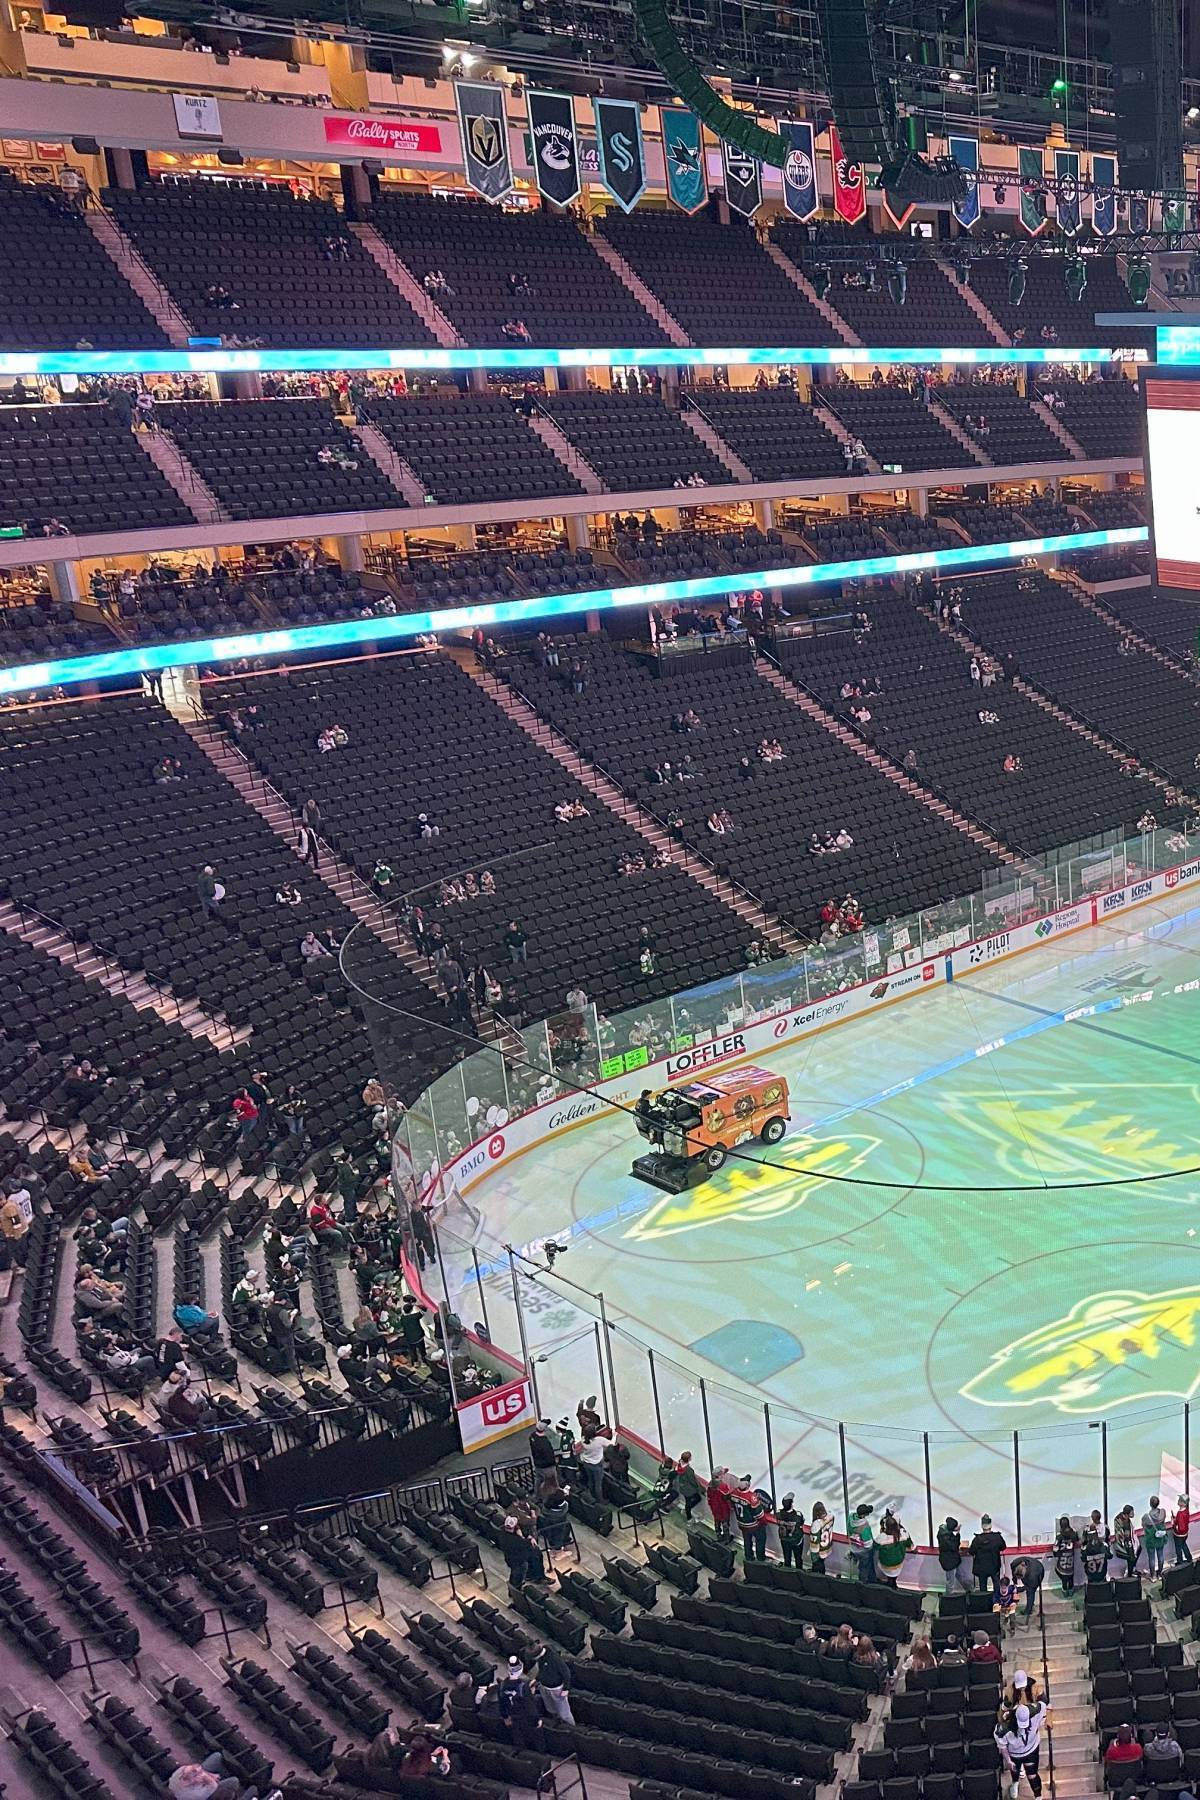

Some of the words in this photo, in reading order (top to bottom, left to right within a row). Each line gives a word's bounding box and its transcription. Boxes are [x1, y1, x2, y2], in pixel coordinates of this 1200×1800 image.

[348, 120, 388, 144] Bally
[390, 130, 420, 142] SPORTS
[534, 123, 573, 142] VANCOUVER
[789, 165, 809, 176] OILERS
[1166, 872, 1178, 885] us
[1055, 909, 1078, 922] Regions
[1055, 914, 1080, 931] Hospital
[987, 933, 1010, 952] PILOT
[891, 977, 912, 990] STREAM
[913, 974, 921, 982] ON
[793, 1011, 815, 1027] Xcel
[815, 1001, 846, 1019] Energy
[666, 1034, 745, 1075] LOFFLER
[548, 1102, 596, 1129] Golden
[600, 1090, 630, 1107] LGHT
[460, 1151, 485, 1178] BMO
[486, 1393, 523, 1421] us
